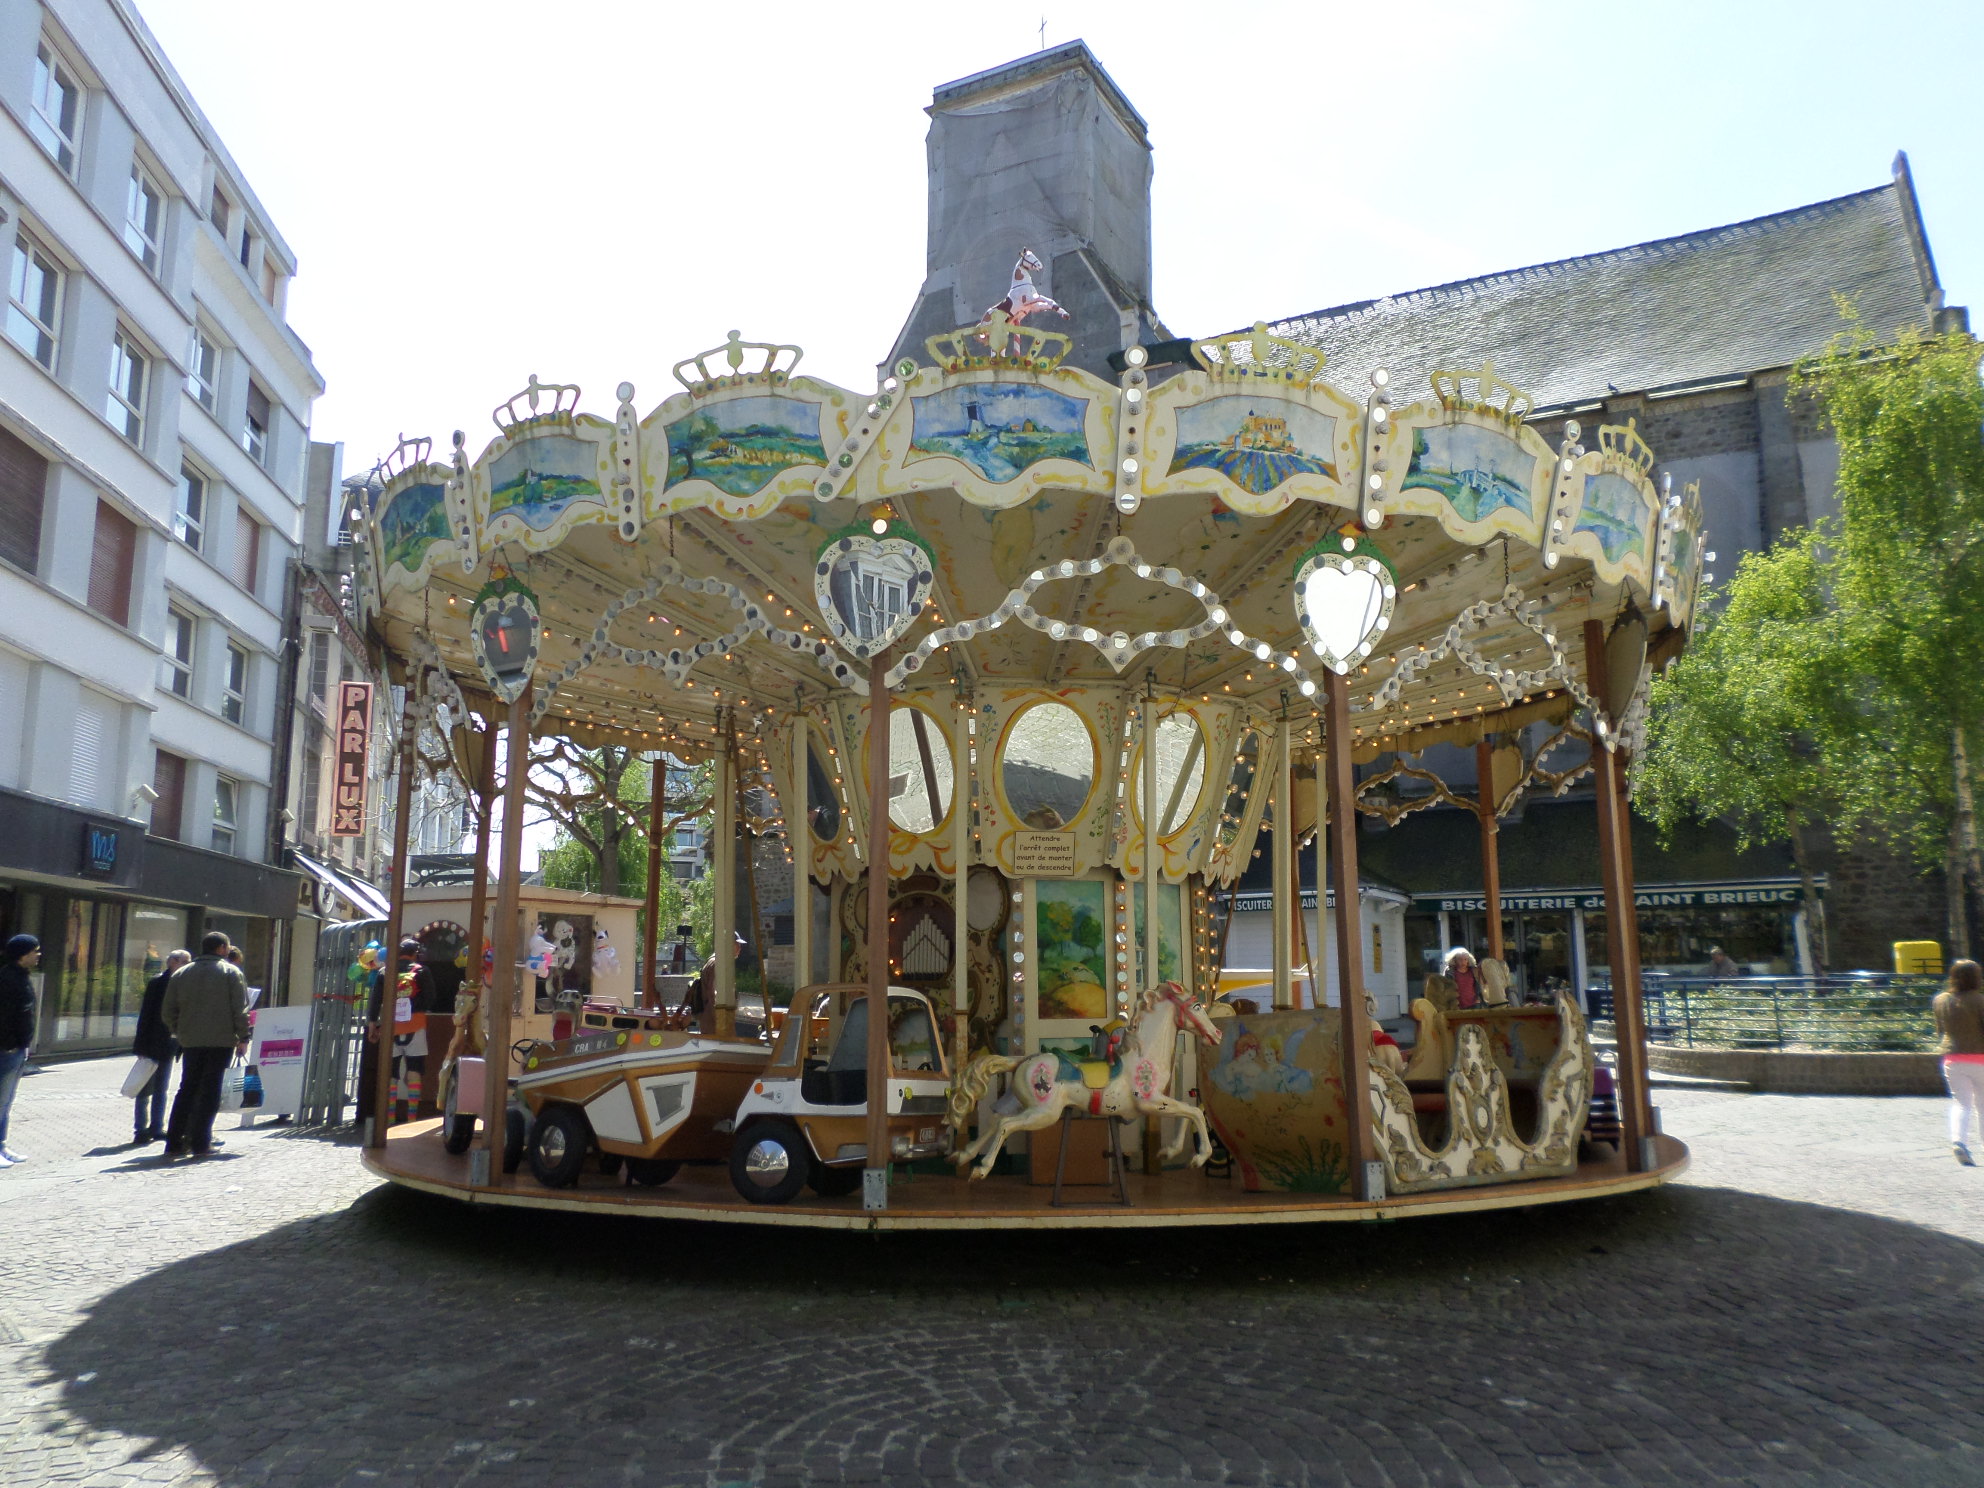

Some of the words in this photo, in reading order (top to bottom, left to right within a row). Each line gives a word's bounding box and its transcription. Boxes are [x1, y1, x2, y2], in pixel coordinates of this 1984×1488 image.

[1044, 845, 1070, 853] complet
[1635, 894, 1696, 906] AINT
[1703, 890, 1796, 904] BRIEUC
